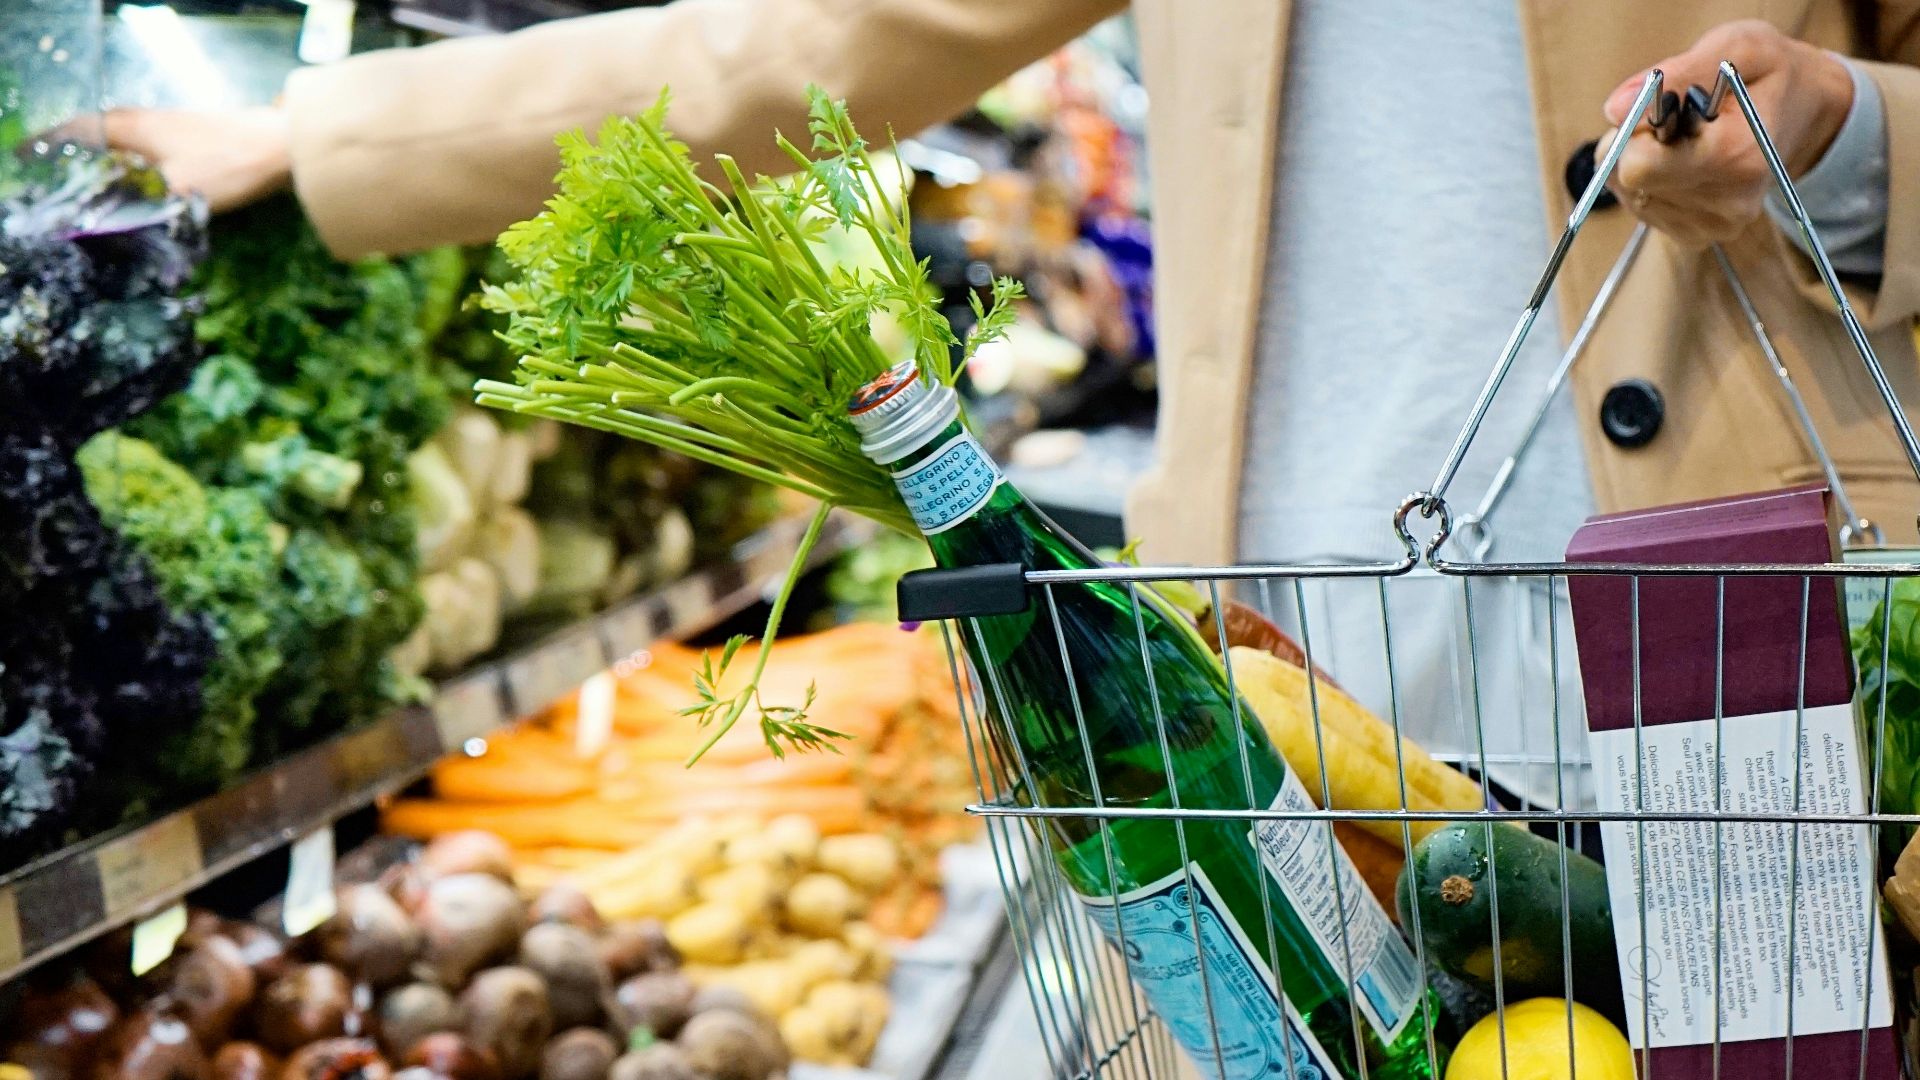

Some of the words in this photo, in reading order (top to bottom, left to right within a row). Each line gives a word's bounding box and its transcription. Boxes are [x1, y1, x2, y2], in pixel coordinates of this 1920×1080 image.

[1682, 737, 1692, 758] Seul
[1823, 733, 1834, 773] delicious
[1835, 741, 1844, 751] At
[1617, 755, 1625, 776] vous
[1685, 761, 1692, 773] un
[1695, 751, 1703, 773] avec
[1755, 757, 1765, 771] but
[1765, 750, 1774, 776] these
[1837, 754, 1847, 785] Lesley
[1744, 757, 1754, 791] cheese
[1806, 771, 1814, 786] her
[1620, 779, 1627, 791] ne
[1654, 790, 1661, 801] au
[1685, 775, 1698, 807] produit
[1698, 776, 1707, 797] soin,
[1758, 774, 1768, 798] really
[1769, 779, 1779, 810] unique
[1818, 784, 1826, 799] are
[1829, 777, 1839, 799] food.
[1701, 800, 1708, 812] en
[1721, 788, 1730, 811] Stow
[1738, 792, 1746, 814] snac
[1749, 794, 1756, 802] or
[1808, 790, 1817, 813] team
[1761, 802, 1770, 826] she
[1832, 802, 1841, 830] The
[1625, 831, 1636, 850] plus
[1649, 830, 1657, 841] de
[1681, 822, 1694, 855] pouvait
[1704, 821, 1713, 845] etites
[1765, 829, 1774, 853] when
[1775, 822, 1785, 852] ackers
[1812, 822, 1822, 839] ink
[1824, 832, 1834, 850] with
[1661, 841, 1669, 857] ces
[1671, 837, 1683, 867] POUR
[1802, 829, 1814, 863] scratch
[1815, 842, 1823, 856] the
[1836, 833, 1847, 872] fabulous
[1704, 742, 1713, 753] de
[1721, 863, 1732, 901] fabuleux
[1727, 904, 1739, 951] craquelins
[1733, 954, 1743, 973] sont
[1729, 843, 1739, 871] Foods
[1746, 855, 1754, 869] are
[1757, 852, 1765, 868] We
[1779, 855, 1787, 869] are
[1827, 852, 1835, 872] care
[1848, 843, 1858, 872] Foods
[1687, 858, 1699, 898] satisfaire
[1759, 871, 1767, 886] are
[1768, 857, 1780, 888] topped
[1807, 866, 1816, 890] using
[1817, 859, 1826, 878] only
[1663, 860, 1676, 907] craquelins
[1676, 870, 1686, 891] CES
[1733, 874, 1742, 900] adore
[1748, 872, 1757, 892] sure
[1820, 881, 1828, 899] way
[1830, 876, 1838, 884] in
[1841, 875, 1851, 903] crisps
[1852, 875, 1859, 888] we
[1657, 893, 1666, 905] de
[1679, 894, 1690, 917] FINS
[1702, 887, 1711, 908] avec
[1750, 895, 1759, 912] you
[1773, 890, 1783, 909] with
[1810, 893, 1818, 908] our
[1823, 902, 1830, 910] to
[1831, 887, 1842, 912] small
[1854, 891, 1862, 910] love
[1693, 902, 1703, 930] Lesley
[1705, 910, 1713, 927] des
[1762, 889, 1774, 928] addicted
[1845, 905, 1854, 926] from
[1659, 908, 1670, 945] fromage
[1670, 910, 1680, 929] sont
[1737, 903, 1748, 944] fabriquer
[1754, 914, 1763, 929] will
[1774, 912, 1784, 931] your
[1812, 910, 1823, 936] finest
[1824, 913, 1834, 938] make
[1857, 913, 1867, 946] making
[1698, 934, 1706, 942] et
[1756, 932, 1764, 943] be
[1767, 931, 1775, 939] to
[1835, 914, 1845, 953] batches.
[1665, 948, 1672, 960] ou
[1682, 920, 1699, 987] CRAQUELINS
[1699, 945, 1707, 961] son
[1743, 947, 1751, 955] et
[1769, 942, 1777, 958] this
[1724, 966, 1732, 978] de
[1744, 958, 1753, 979] vous
[1827, 950, 1839, 973] great
[1769, 961, 1781, 994] yummy
[1795, 978, 1804, 997] own
[1853, 968, 1864, 1001] kitchen
[1747, 982, 1757, 1002] offrir
[1830, 976, 1844, 1010] product
